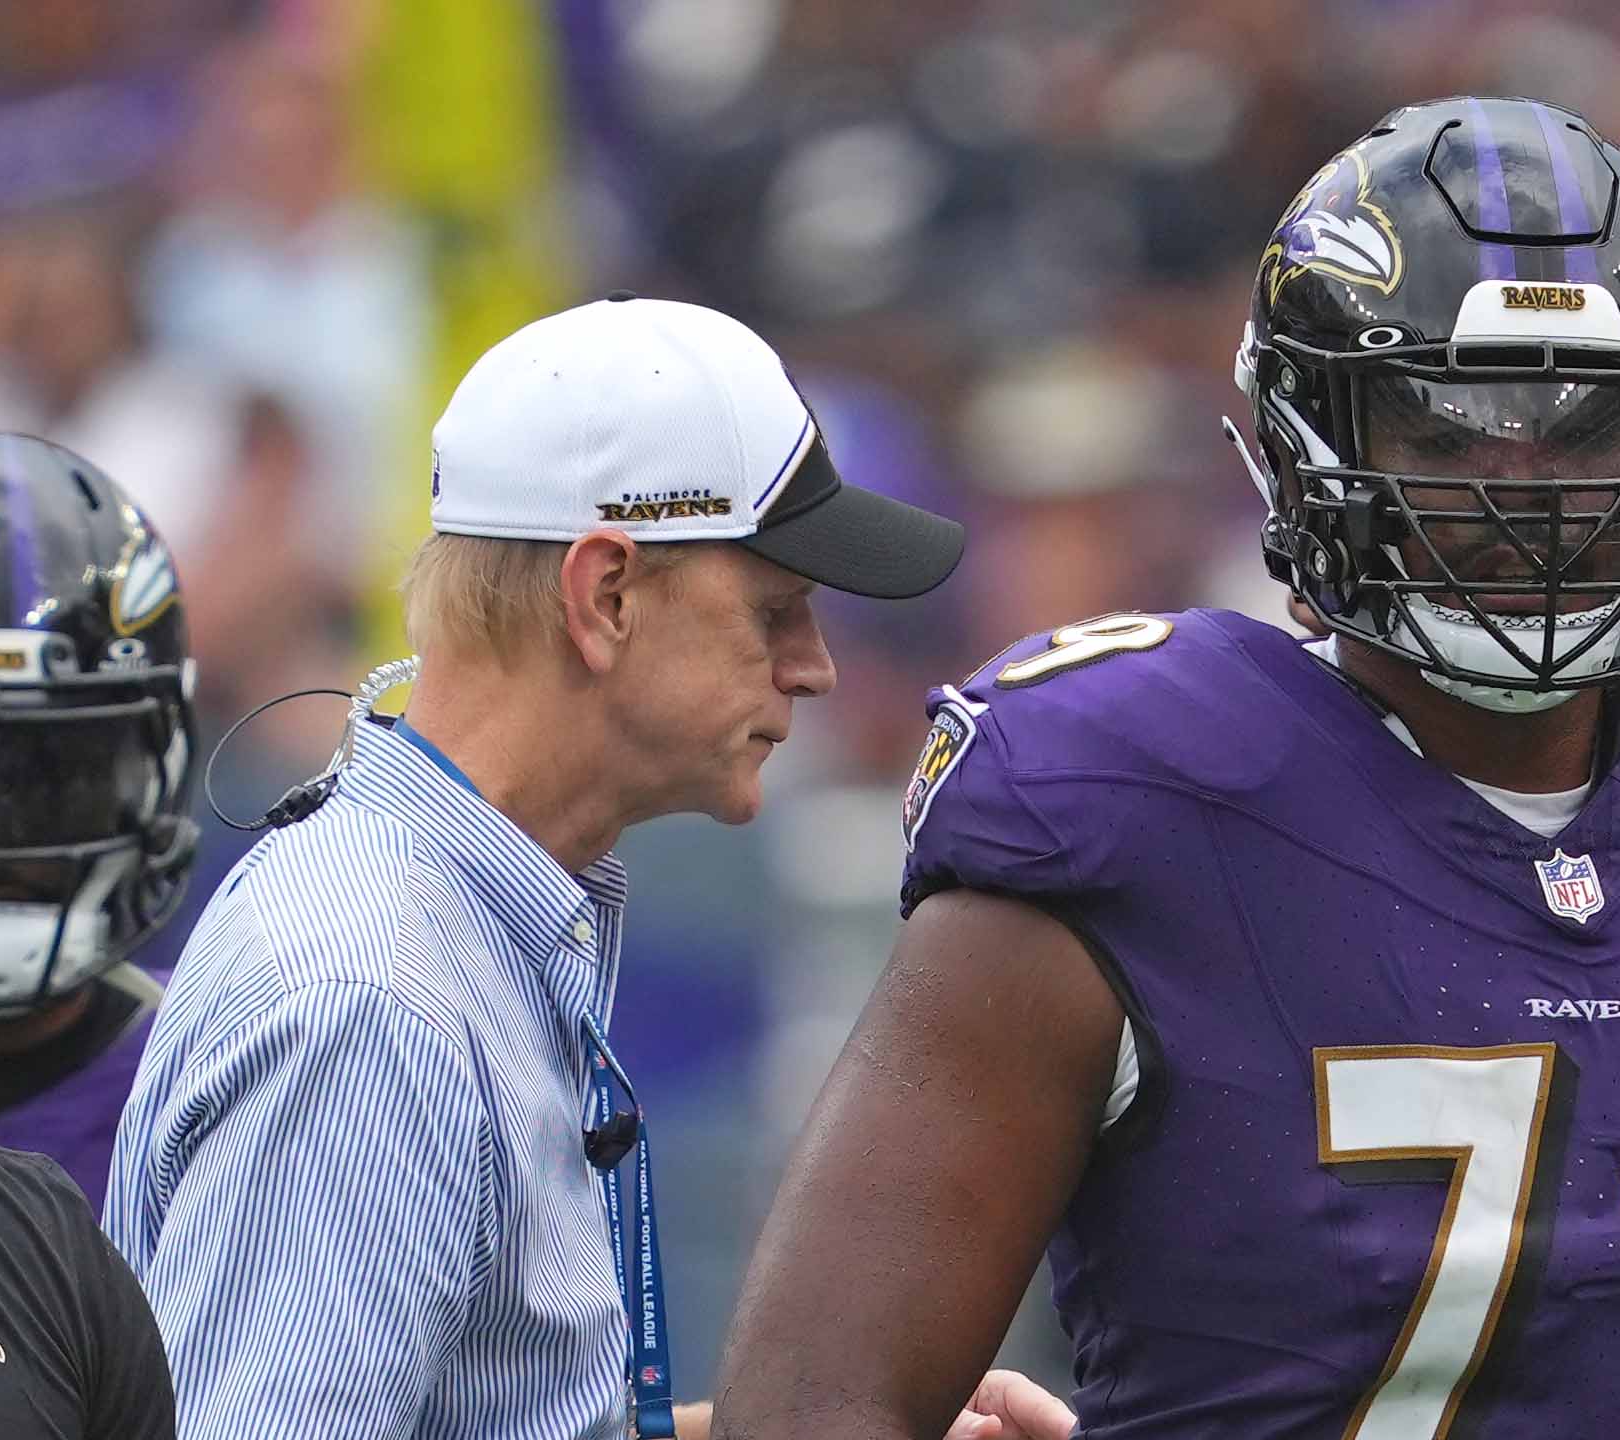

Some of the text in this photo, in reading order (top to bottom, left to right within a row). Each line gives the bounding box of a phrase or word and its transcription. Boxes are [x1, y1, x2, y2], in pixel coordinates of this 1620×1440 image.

[1500, 286, 1586, 312] RAVENS
[622, 488, 712, 503] BALTIMORE
[595, 498, 733, 523] RAVENS
[1554, 880, 1595, 909] NFL
[641, 1214, 653, 1290] FOOTBALL
[643, 1292, 657, 1349] LEAGUE
